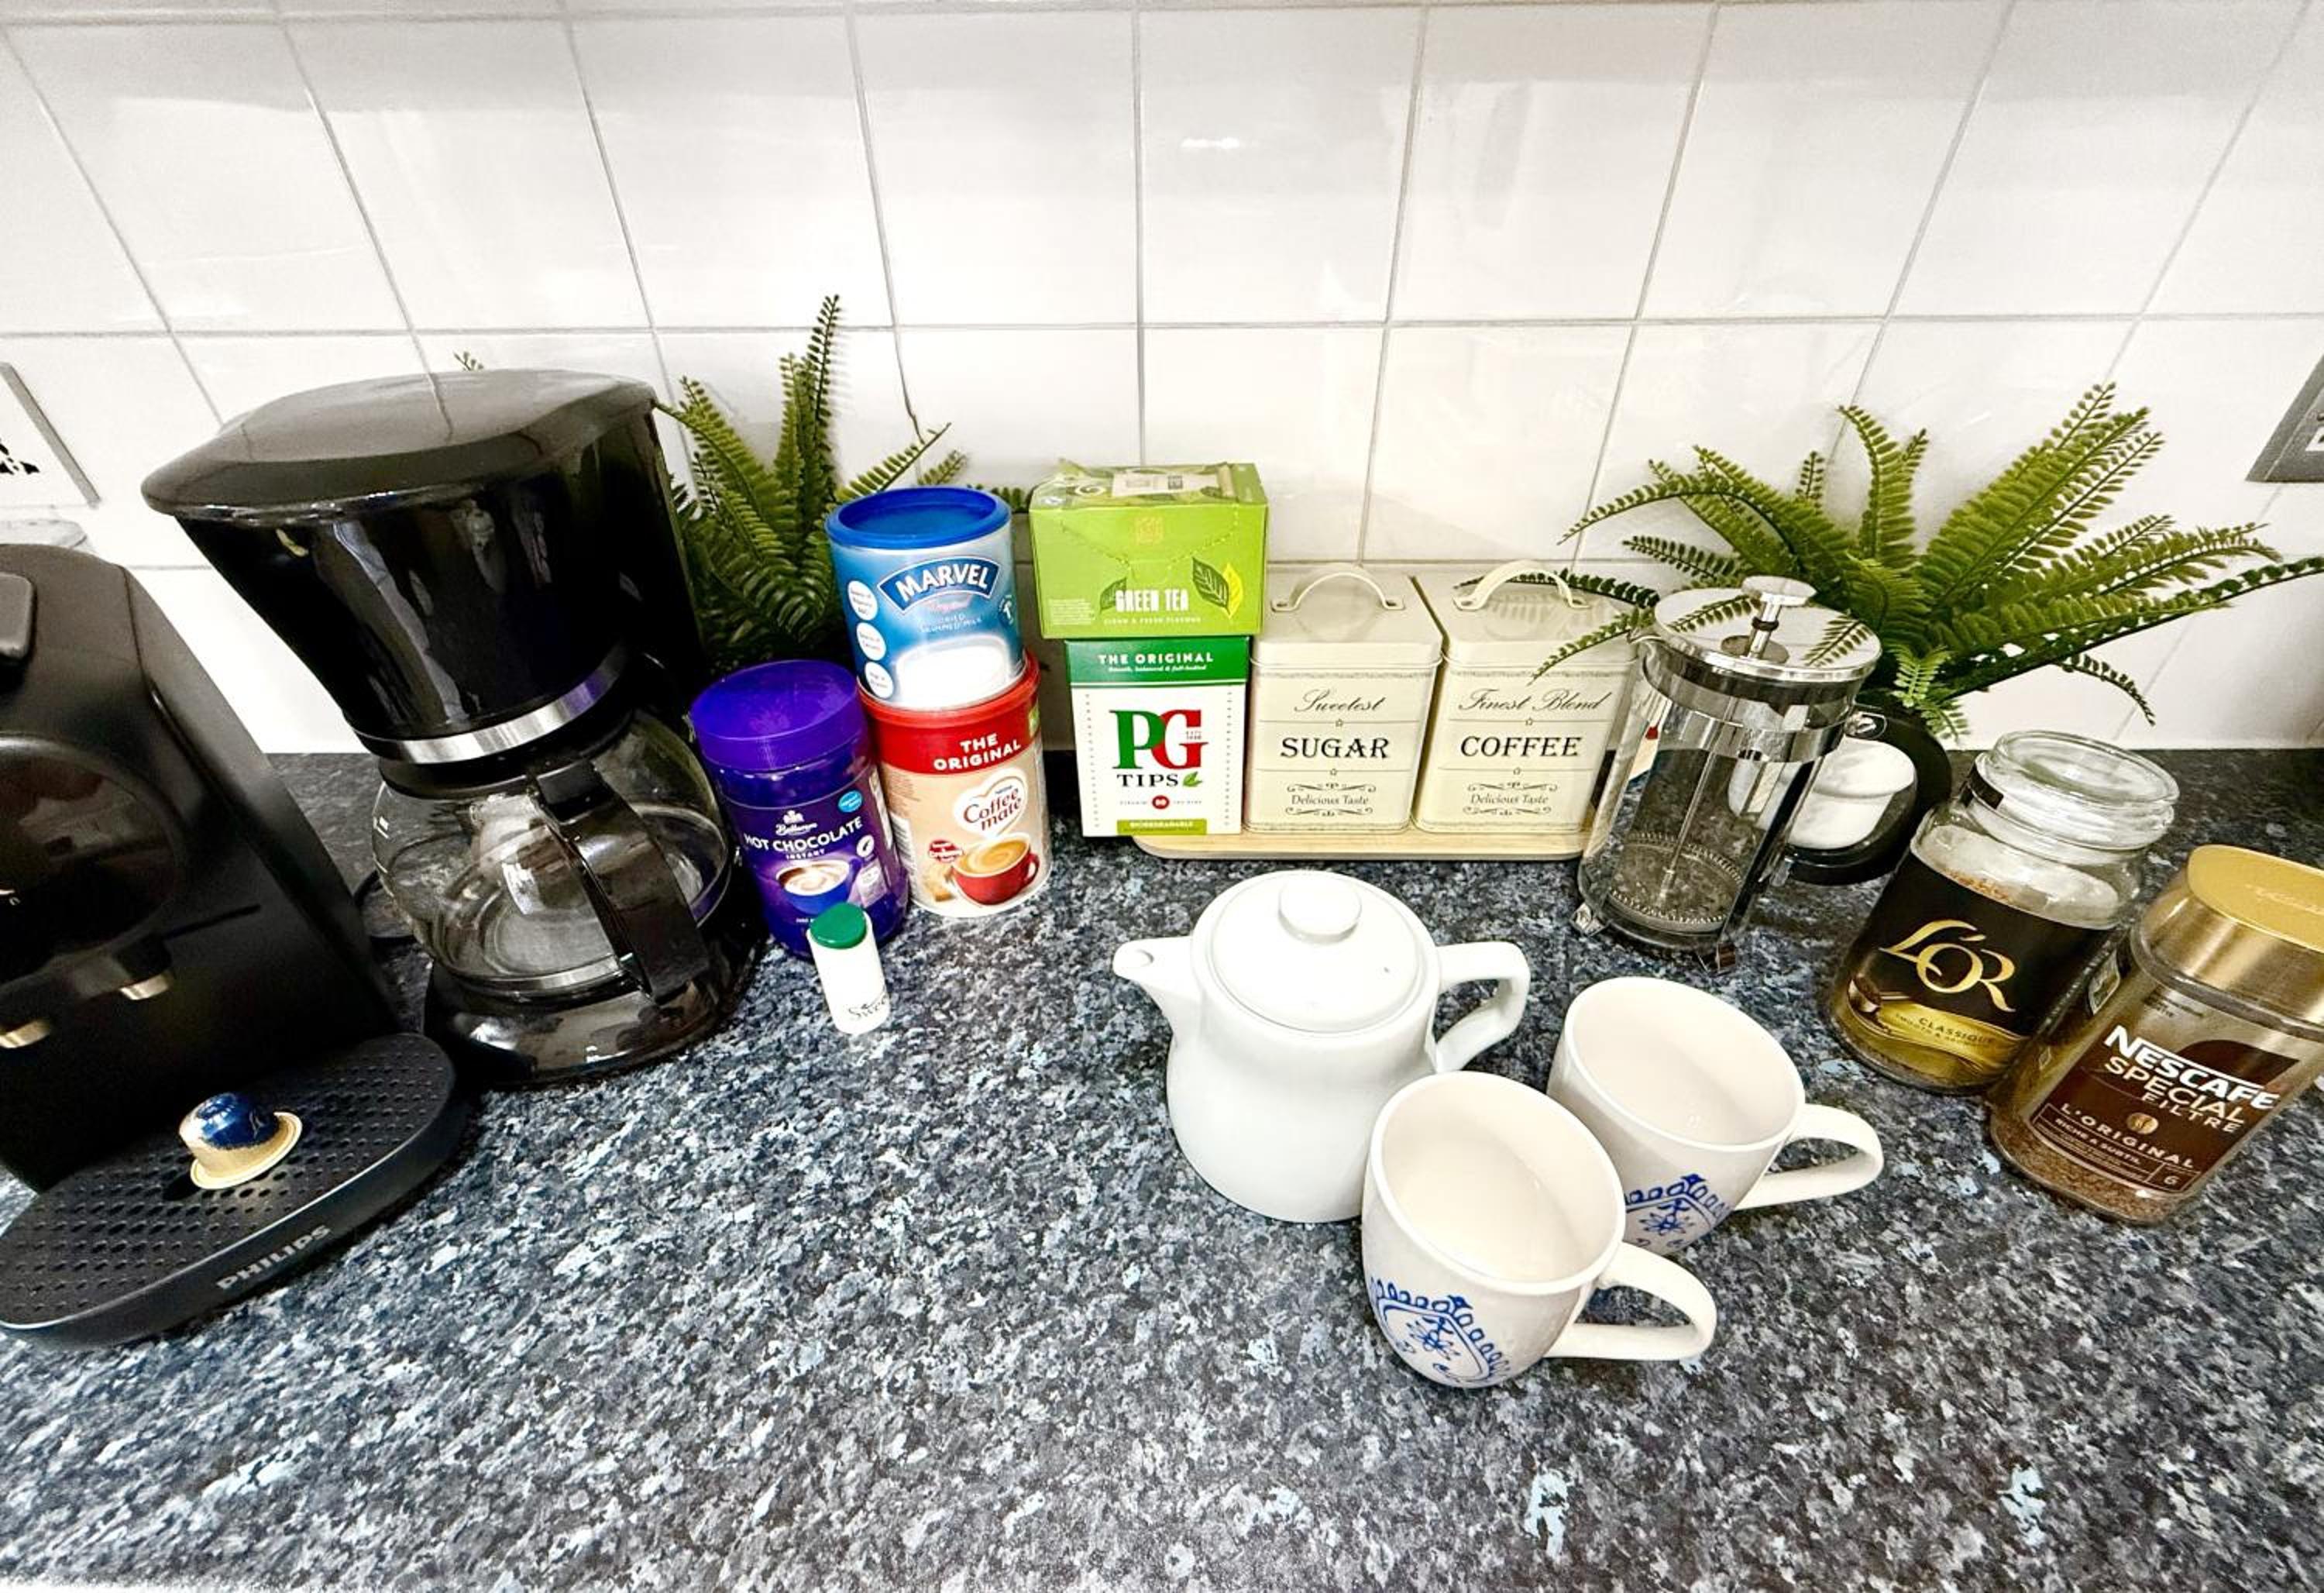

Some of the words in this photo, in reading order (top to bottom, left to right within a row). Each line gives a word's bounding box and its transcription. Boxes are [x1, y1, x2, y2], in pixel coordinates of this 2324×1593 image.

[896, 563, 990, 603] MARVEL
[1116, 589, 1160, 612] GREEN
[1164, 589, 1189, 612] TEA
[1098, 653, 1128, 666] THE
[1135, 652, 1214, 665] ORIGINAL
[1294, 689, 1387, 713] Sweetest
[1459, 688, 1532, 711] Finest
[1532, 689, 1612, 712] Blend
[960, 733, 999, 753] THE
[1109, 709, 1209, 770] PG
[1281, 737, 1390, 759] SUGAR
[1460, 736, 1582, 757] COFFEE
[933, 739, 1022, 772] ORIGINAL
[1116, 773, 1179, 788] TIPS
[963, 786, 1019, 824] Coffee
[1291, 794, 1339, 806] Delicious
[1344, 794, 1370, 806] Taste
[1470, 794, 1520, 805] Delicious
[1523, 794, 1549, 805] Taste
[981, 796, 1023, 832] mate
[743, 832, 770, 852] HOT
[773, 816, 863, 854] CHOCOLATE
[786, 848, 826, 860] INSTANT
[2105, 1056, 2246, 1124] SPECIAL
[2140, 1091, 2243, 1134] FILTRE
[2061, 1103, 2195, 1169] L'ORIGINAL
[216, 1224, 332, 1289] PHILIPS
